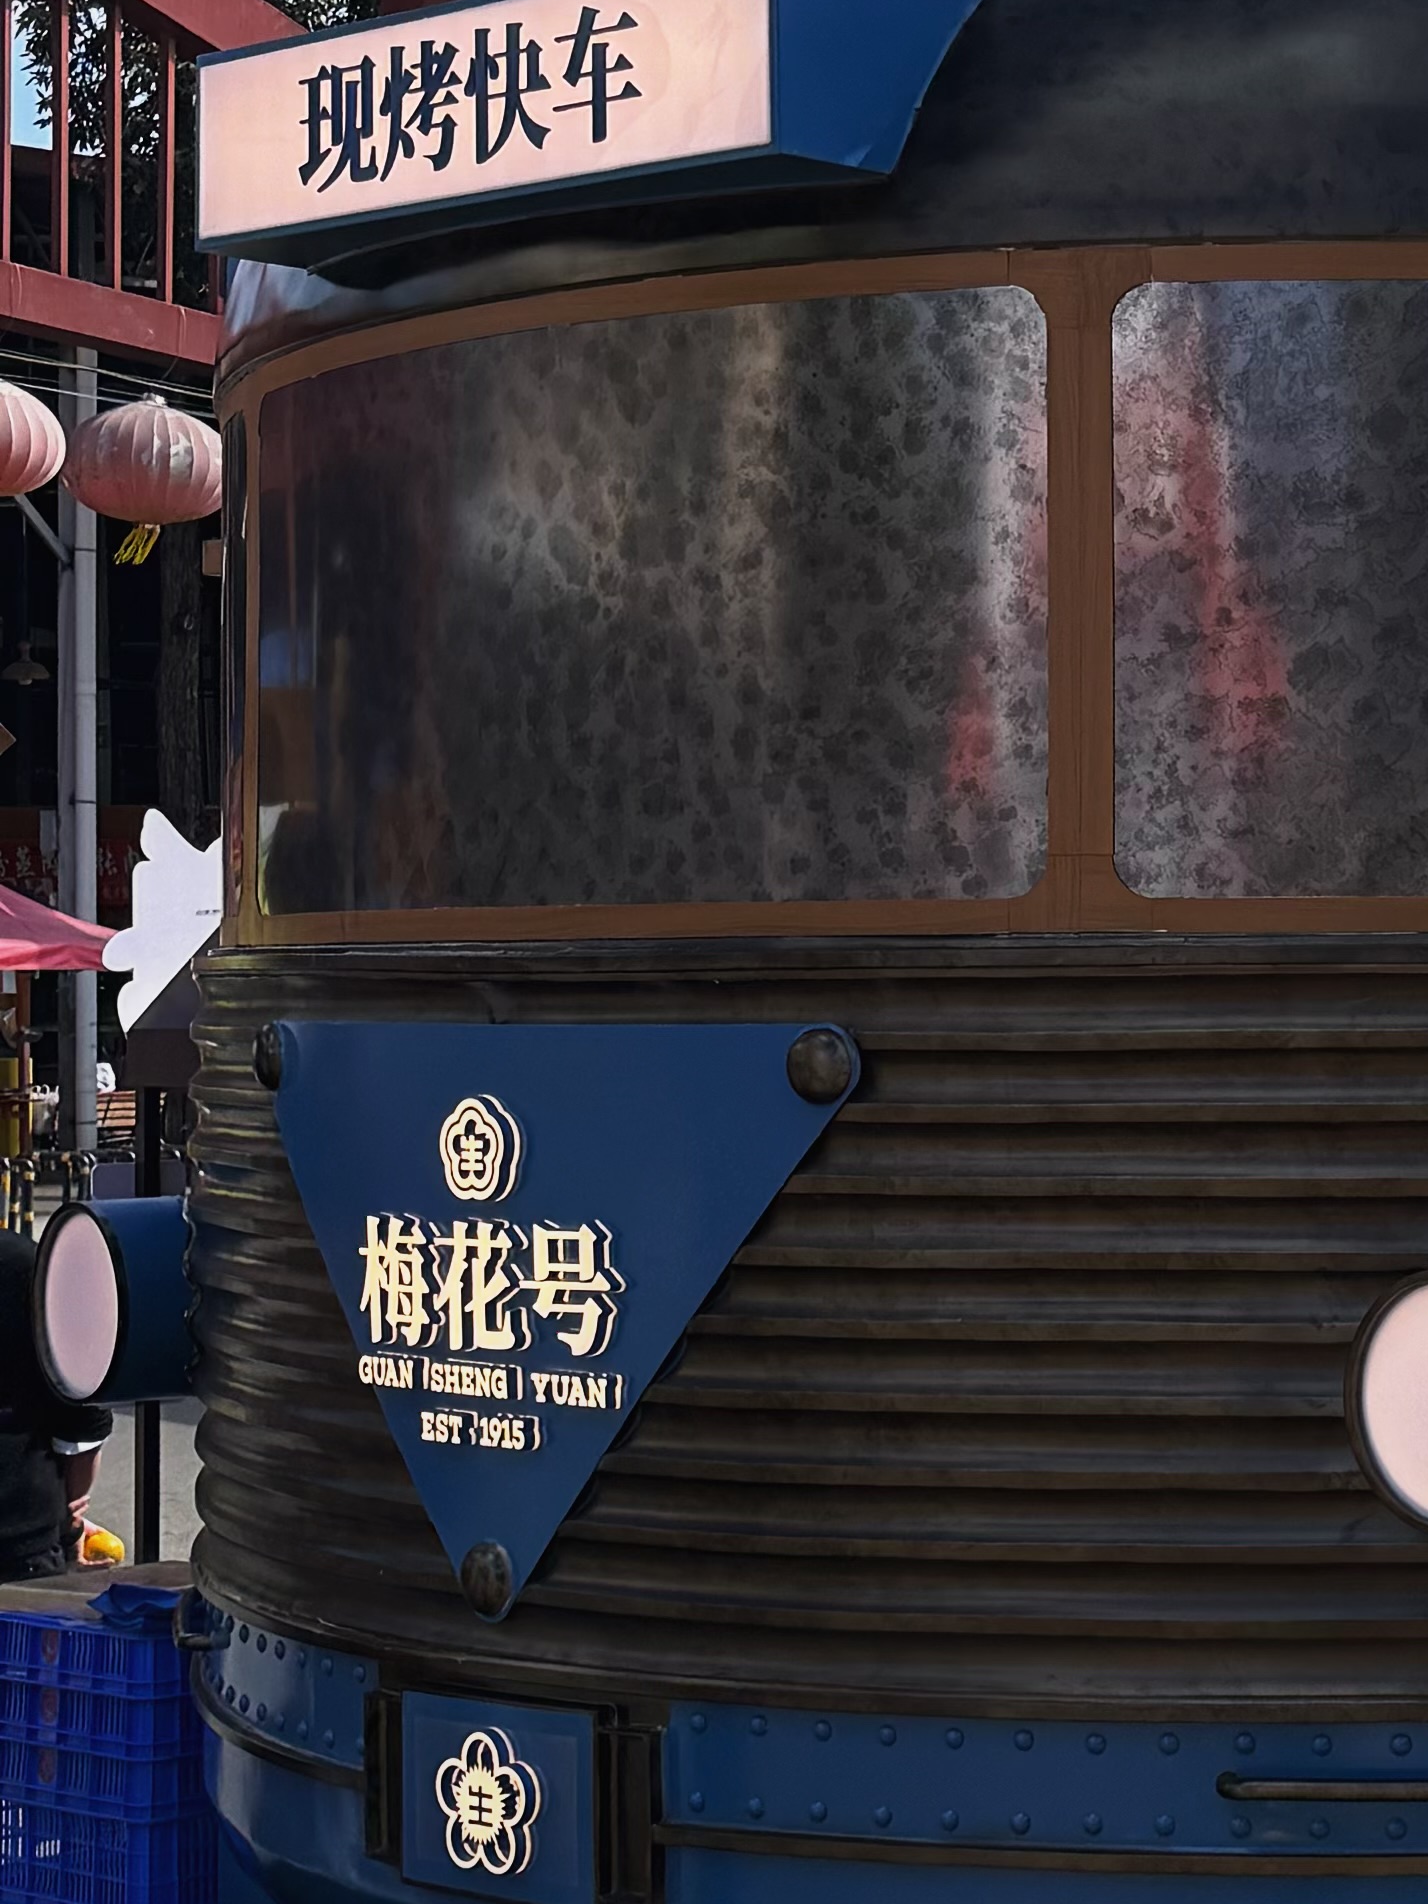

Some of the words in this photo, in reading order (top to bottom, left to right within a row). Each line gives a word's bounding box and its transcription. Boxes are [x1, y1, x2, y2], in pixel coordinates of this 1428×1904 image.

[298, 5, 642, 193] 现烤快车
[358, 1214, 613, 1356] 梅花号
[358, 1354, 414, 1389] GUAN
[430, 1363, 508, 1400] SHENG
[530, 1372, 608, 1409] YUAN
[421, 1411, 462, 1445] EST
[479, 1416, 526, 1451] 1915
